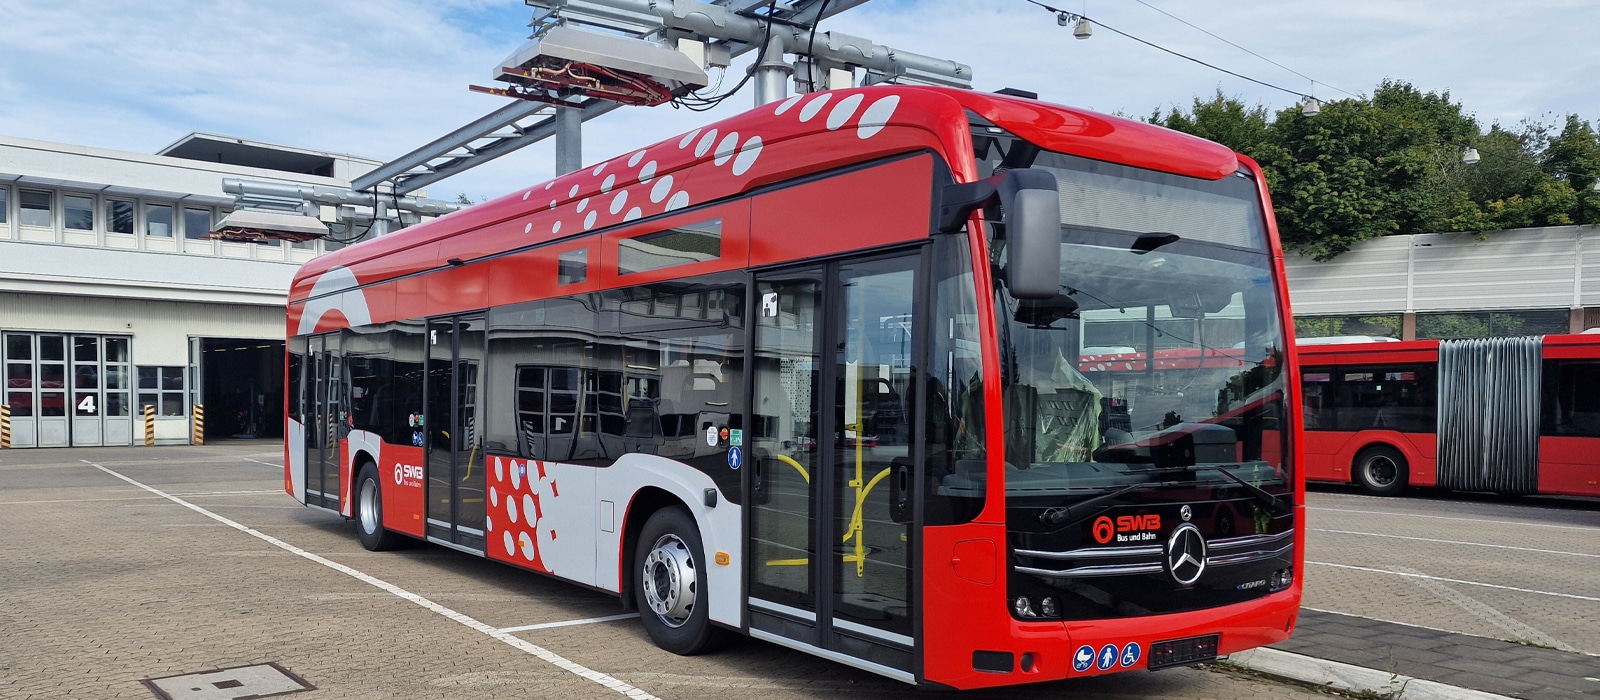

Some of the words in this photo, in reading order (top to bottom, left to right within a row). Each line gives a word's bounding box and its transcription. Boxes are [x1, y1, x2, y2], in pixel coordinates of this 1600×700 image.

[78, 395, 96, 413] 4
[403, 465, 423, 479] SWB
[1117, 514, 1161, 532] SWB
[1117, 534, 1128, 542] Bus
[1129, 533, 1140, 541] und
[1141, 532, 1156, 541] Bahn
